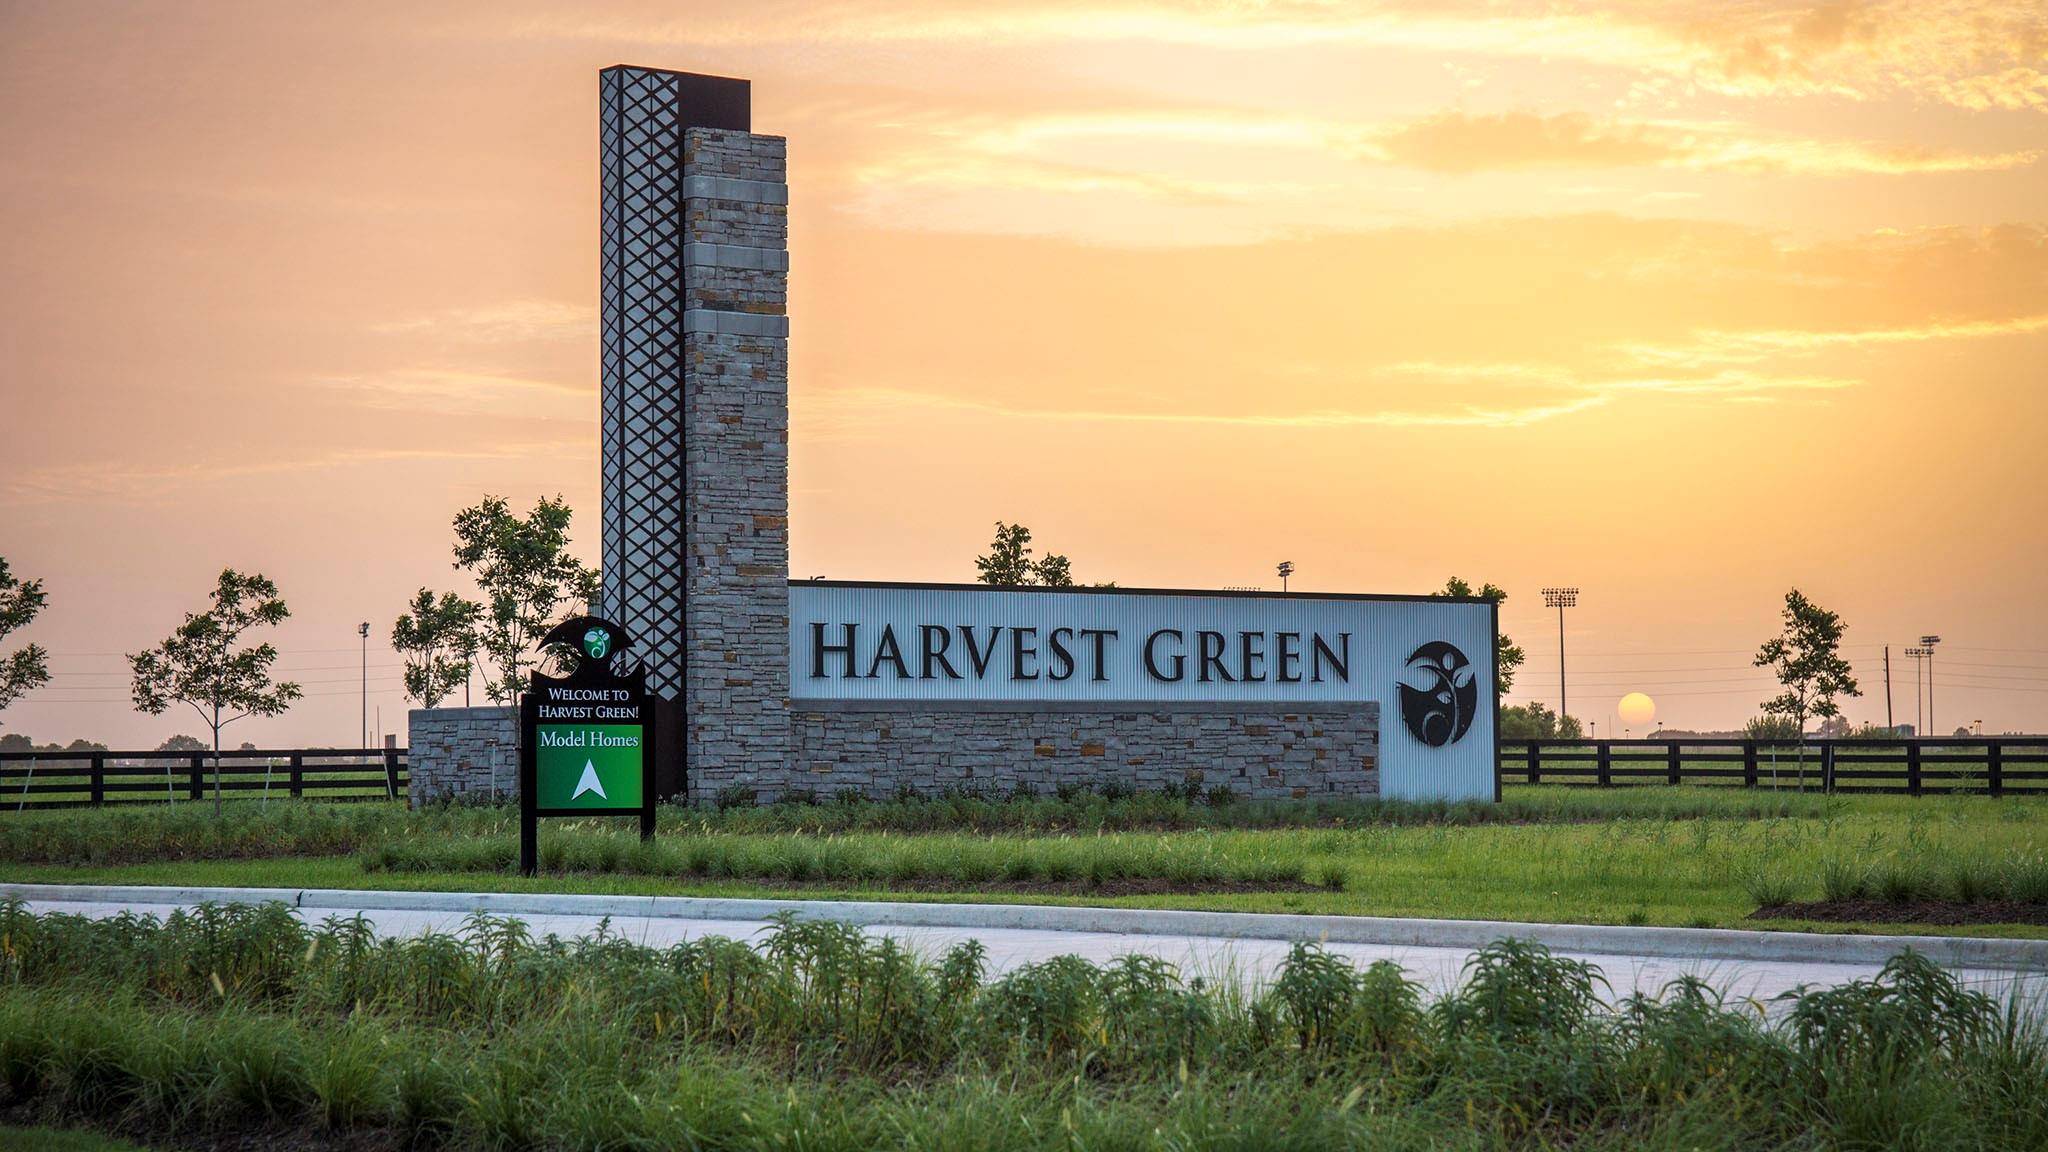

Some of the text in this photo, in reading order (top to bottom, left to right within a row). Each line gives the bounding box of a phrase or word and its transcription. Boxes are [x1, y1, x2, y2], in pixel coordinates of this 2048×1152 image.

[809, 622, 1352, 683] HARVEST GREEN
[548, 688, 629, 701] WELCOME TO
[538, 706, 639, 719] HARVEST GREEN!
[541, 731, 639, 747] Model Homes
